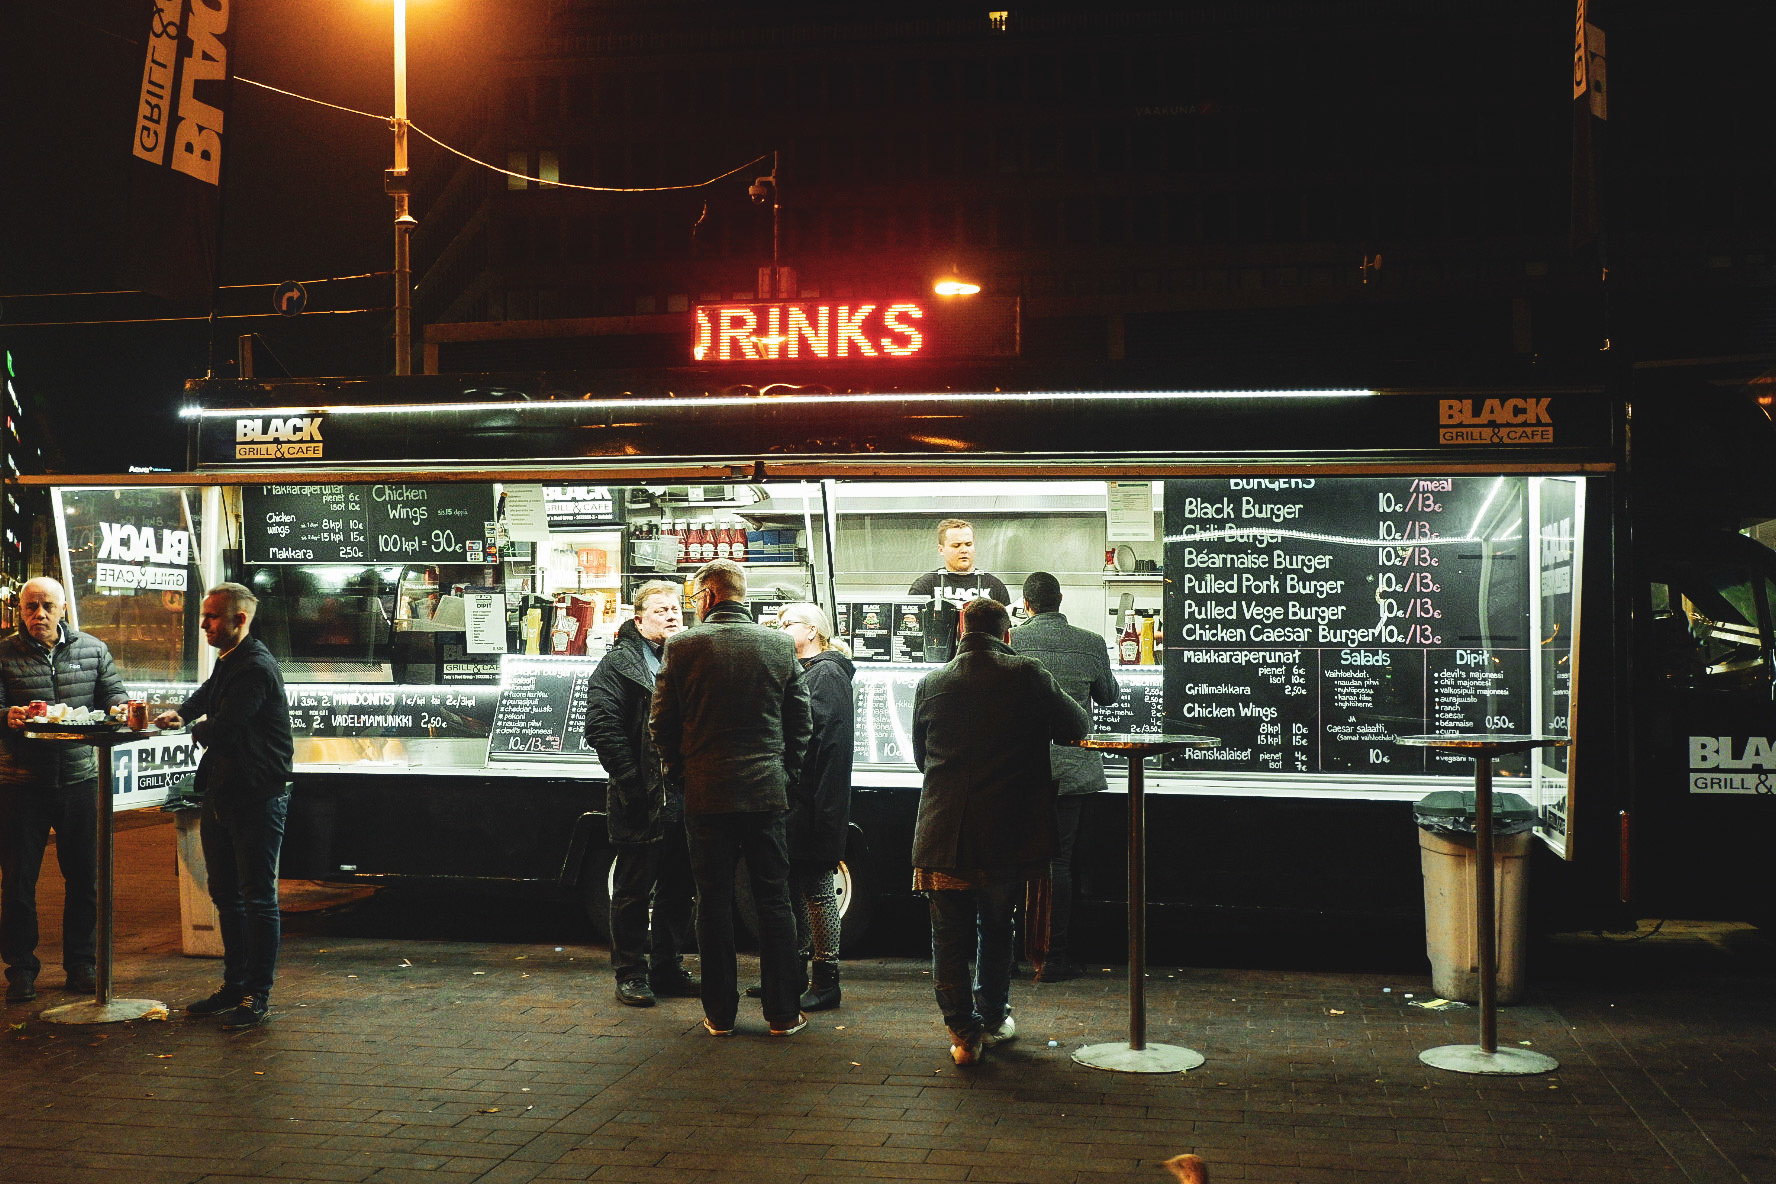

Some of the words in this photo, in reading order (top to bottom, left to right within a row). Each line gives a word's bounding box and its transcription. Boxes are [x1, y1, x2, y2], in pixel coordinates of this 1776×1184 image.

[1439, 398, 1552, 424] BLACK
[236, 417, 324, 442] BLACK
[372, 485, 427, 501] Chicken
[266, 512, 296, 523] Chicken
[388, 504, 428, 525] Wings
[1185, 497, 1235, 518] Black
[1242, 497, 1303, 522] Burger
[267, 524, 290, 537] wings
[1183, 524, 1218, 542] Chili
[1225, 523, 1283, 548] Burger
[379, 534, 400, 552] 100
[402, 536, 419, 555] kpl
[432, 530, 463, 553] 90€
[270, 547, 313, 559] Makkara
[1184, 548, 1268, 568] Béarnaise
[1274, 550, 1333, 573] Burger
[1184, 574, 1237, 594] Pulled
[1242, 574, 1279, 594] Pork
[1287, 574, 1345, 599] Burger
[1184, 600, 1236, 619] Pulled
[1242, 601, 1284, 623] Vege
[1289, 601, 1346, 624] Burger
[1182, 624, 1246, 641] Chicken
[1250, 625, 1312, 642] Caesar
[1319, 624, 1376, 647] Burger
[1341, 649, 1390, 665] Salads
[1456, 650, 1489, 667] Dipit
[1259, 665, 1286, 676] pienet
[1293, 665, 1306, 674] 6€
[1270, 675, 1285, 683] isot
[1292, 675, 1306, 683] 10€
[1185, 684, 1251, 695] Grillimakkara
[1183, 703, 1235, 717] Chicken
[1239, 702, 1278, 721] Wings
[332, 714, 412, 727] VADELMAMUNKKI
[1293, 723, 1308, 734] 10€
[1327, 724, 1354, 732] Caesar
[1293, 736, 1308, 745] 15€
[138, 745, 197, 772] BLACK
[1185, 748, 1252, 760] Ranskalaiset
[1260, 752, 1282, 761] pienet
[1370, 748, 1390, 764] 10€
[1689, 736, 1776, 769] BLA
